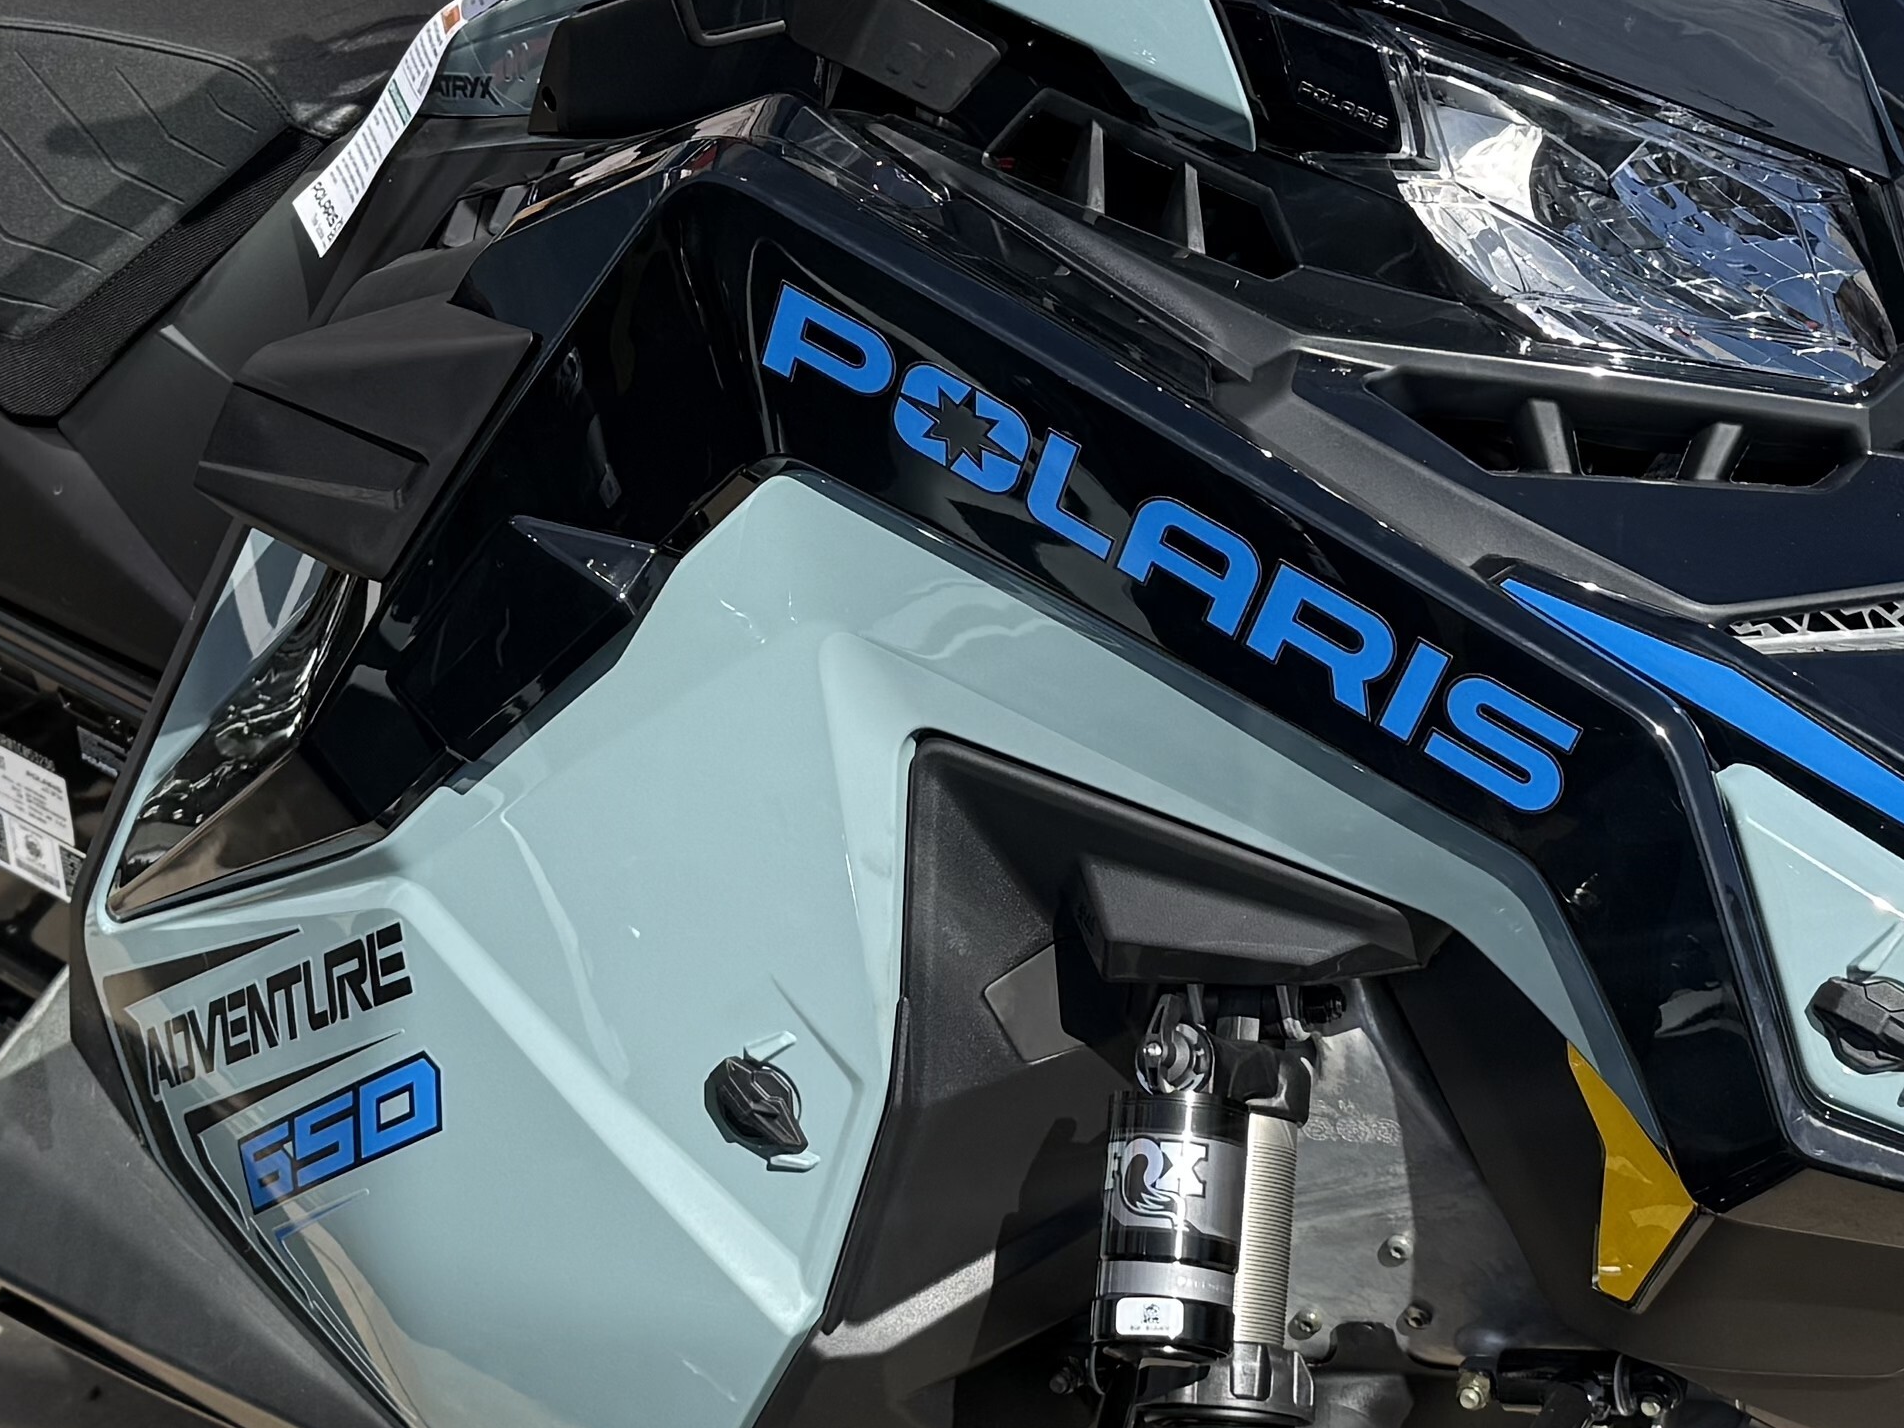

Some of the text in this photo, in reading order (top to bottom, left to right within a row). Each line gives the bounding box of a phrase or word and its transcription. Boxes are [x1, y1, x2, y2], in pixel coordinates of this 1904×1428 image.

[431, 72, 505, 108] ATRYX
[1296, 78, 1391, 130] POLARIS
[760, 278, 1584, 814] POLARIS
[145, 920, 413, 1099] ADVENTURE
[236, 1050, 444, 1215] 650
